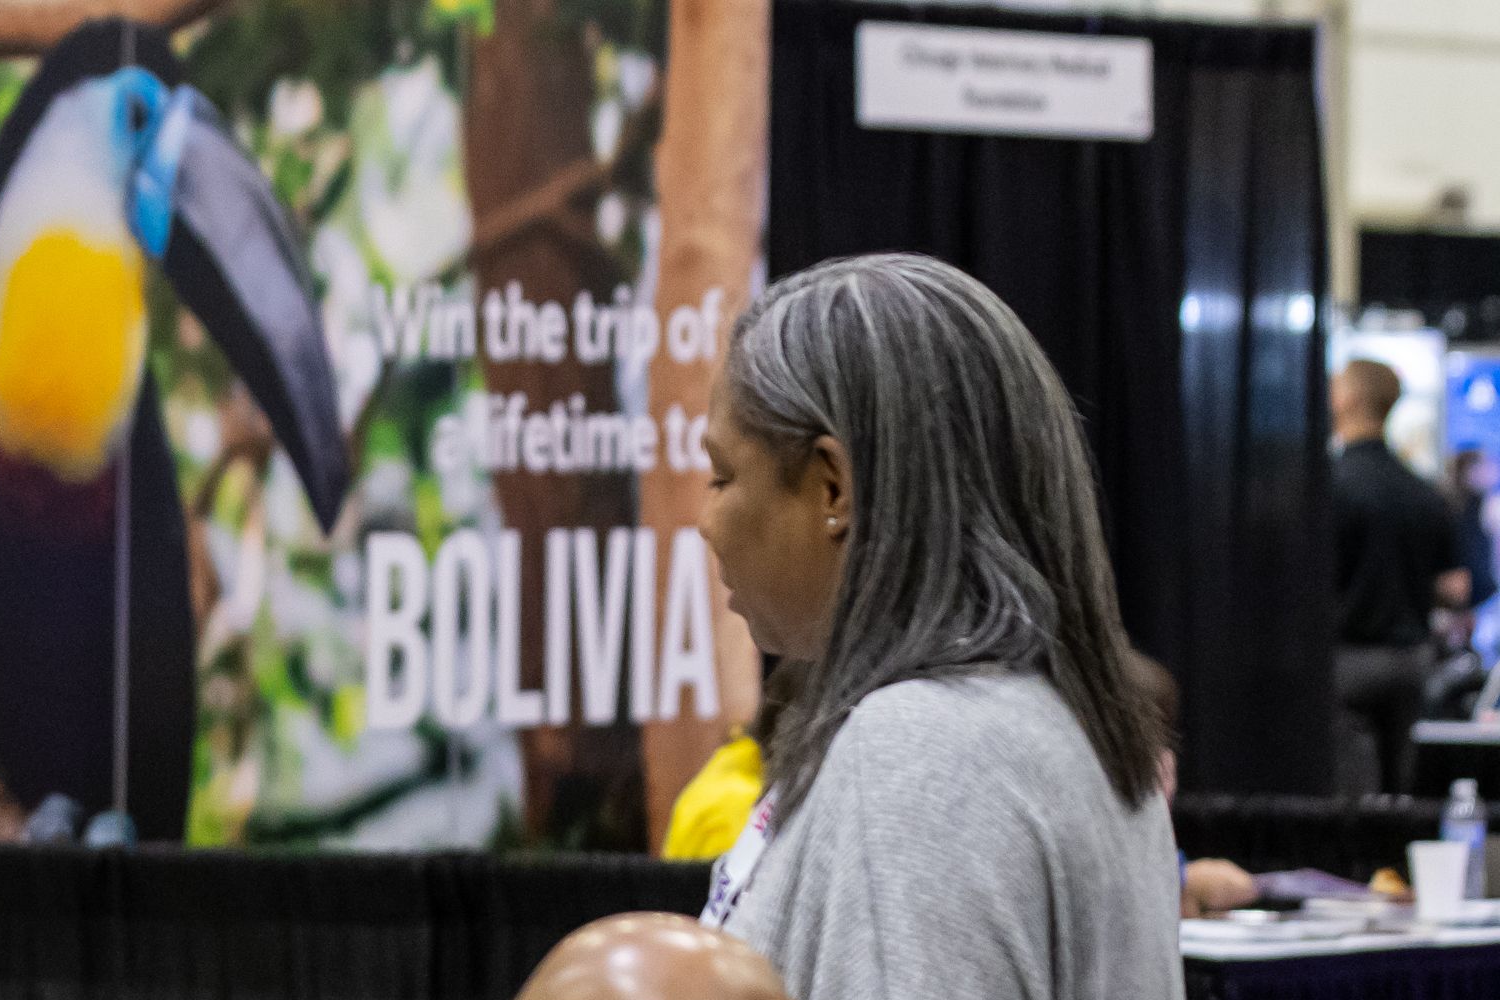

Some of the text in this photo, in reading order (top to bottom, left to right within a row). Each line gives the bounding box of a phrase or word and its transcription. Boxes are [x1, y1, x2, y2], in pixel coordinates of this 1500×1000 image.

[372, 281, 724, 372] Win the trip of
[480, 391, 659, 472] lifetime
[366, 526, 720, 728] BOLIVIA
